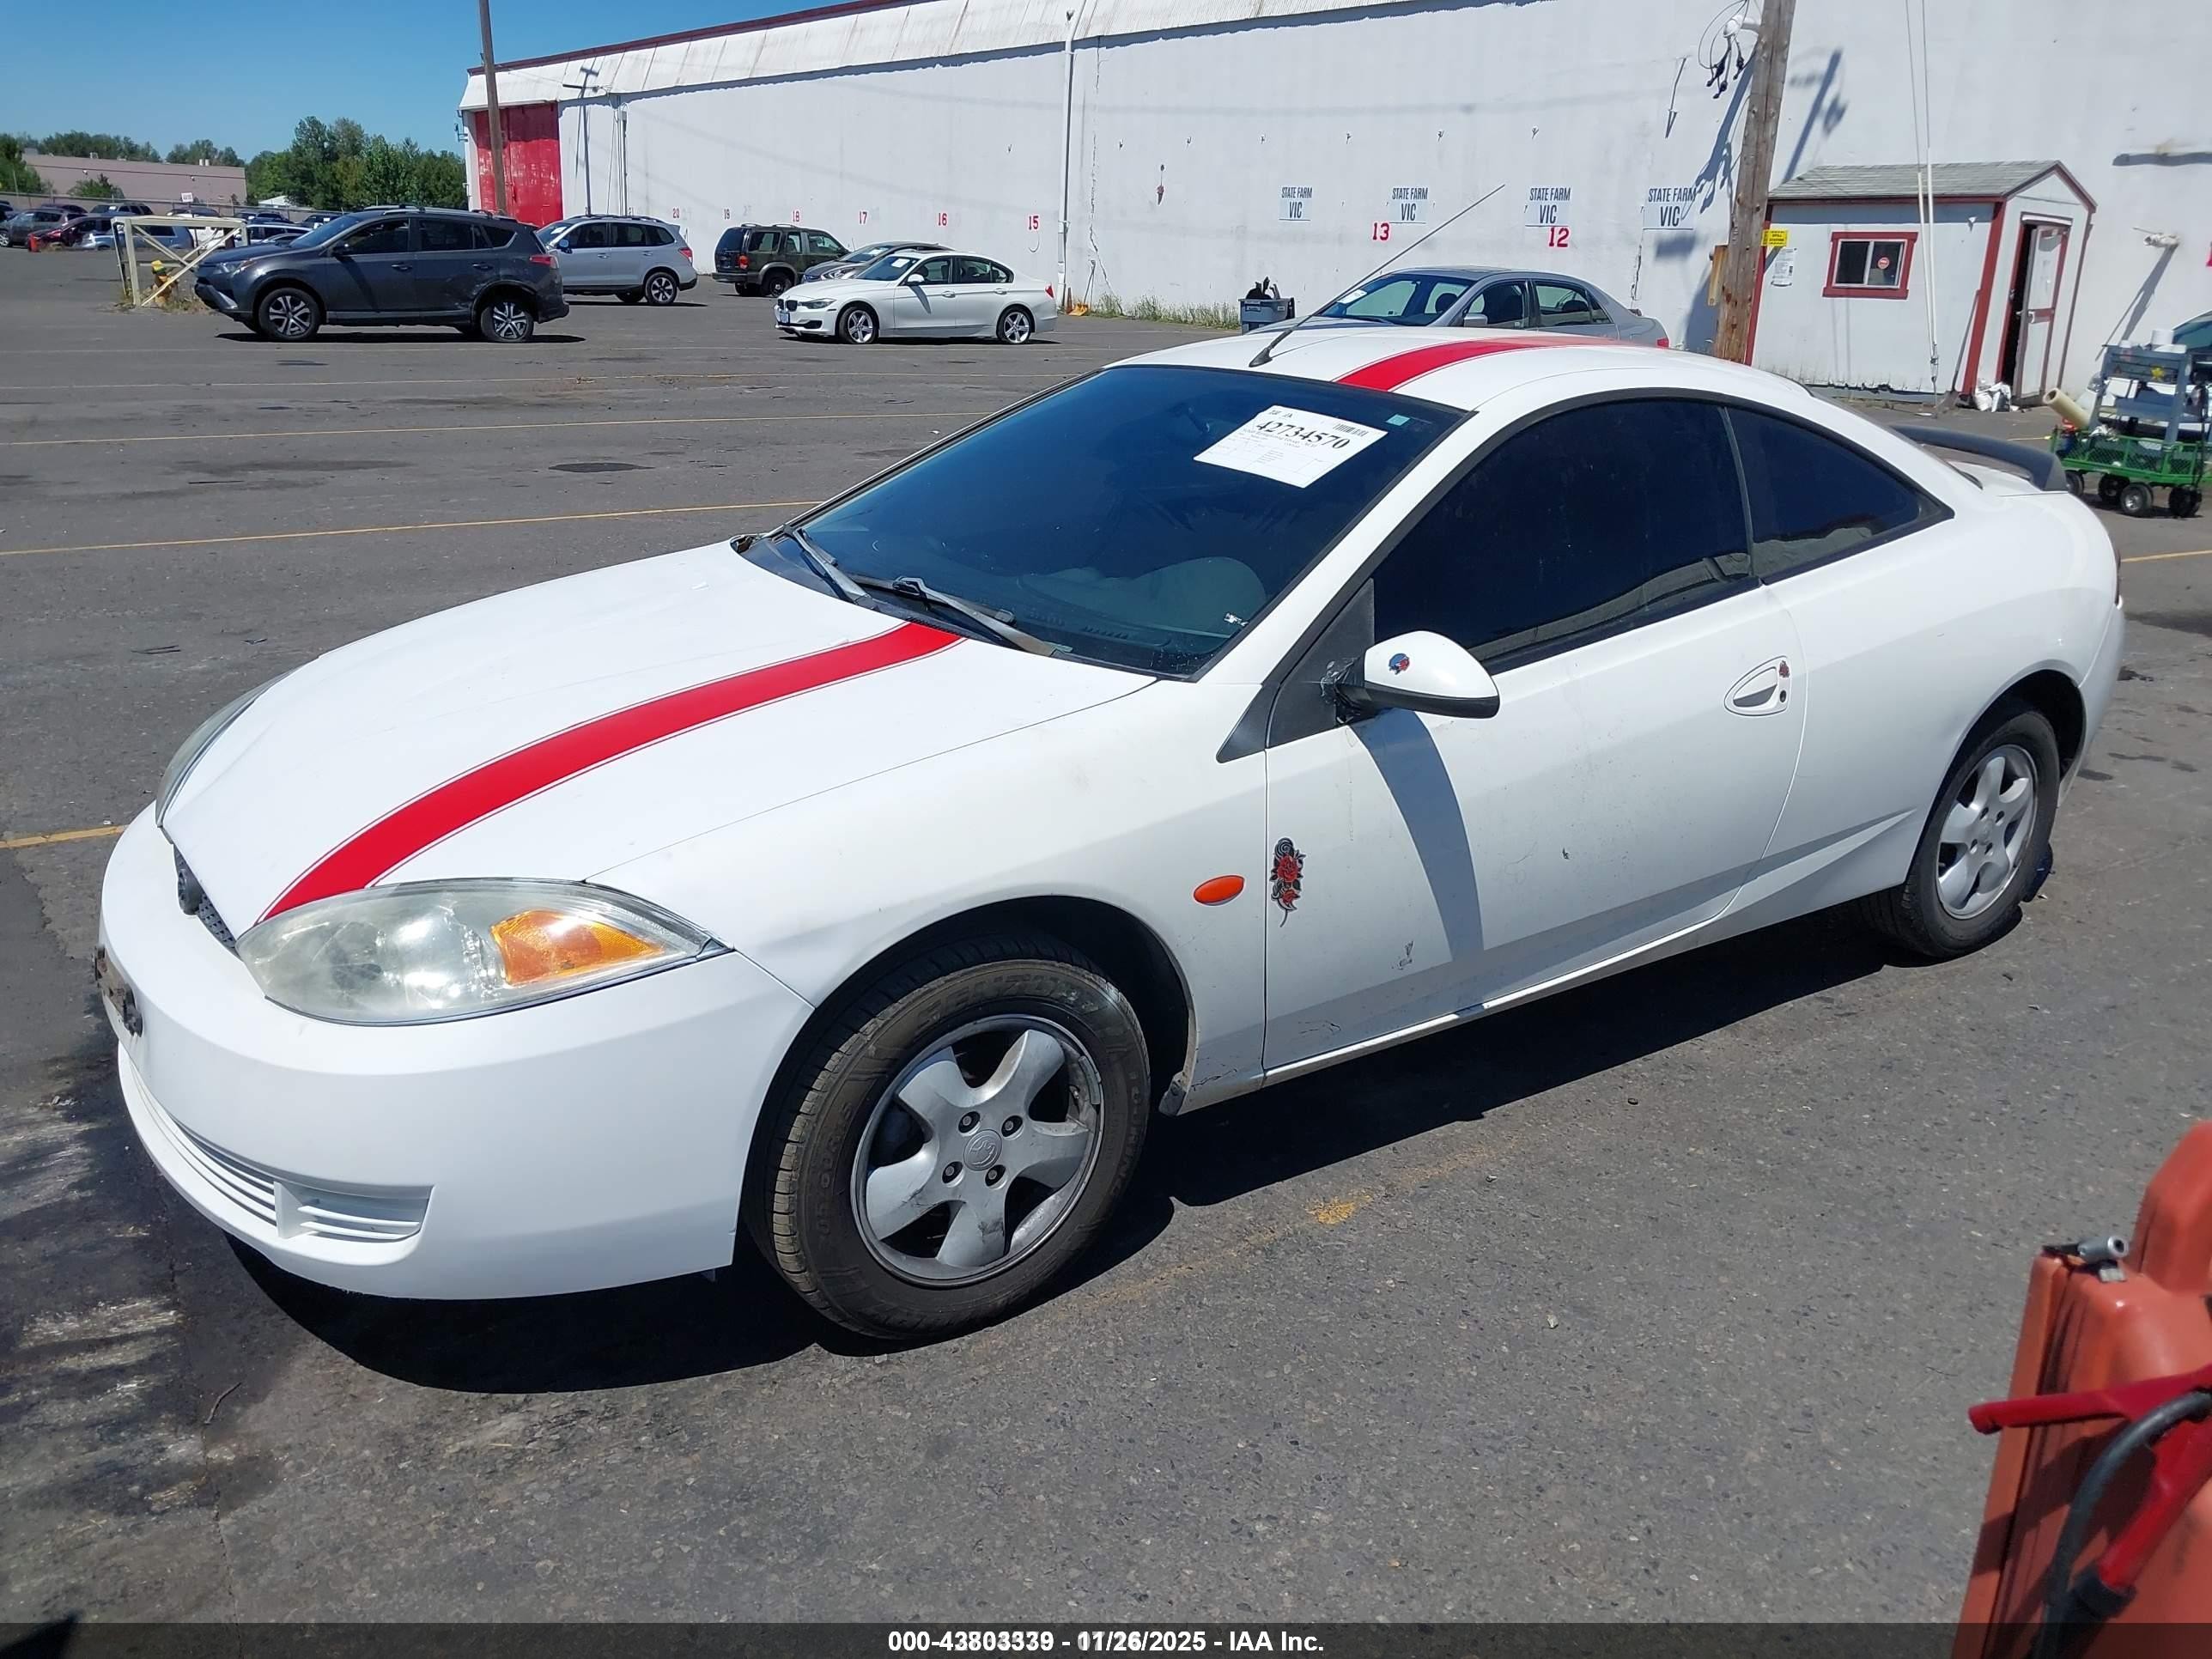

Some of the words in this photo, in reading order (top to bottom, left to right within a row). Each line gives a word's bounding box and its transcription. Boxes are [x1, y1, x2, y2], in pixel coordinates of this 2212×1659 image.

[1281, 186, 1297, 199] STATE
[1297, 186, 1313, 199] FARM
[1392, 187, 1410, 200] STATE
[1410, 187, 1428, 200] FARM
[1529, 187, 1549, 201] STATE
[1549, 187, 1571, 201] FARM
[1648, 188, 1671, 203] STATE
[1672, 187, 1697, 203] FARM
[672, 208, 680, 219] 20
[724, 208, 731, 220] 19
[793, 210, 800, 222] 18
[859, 211, 867, 224] 17
[1289, 202, 1303, 219] VIC
[1401, 203, 1417, 222] VIC
[1539, 204, 1557, 224] VIC
[1660, 206, 1680, 227] VIC
[938, 212, 948, 226] 16
[1028, 216, 1039, 230] 15
[1372, 222, 1390, 240] 13
[1548, 228, 1570, 248] 12
[1256, 420, 1351, 449] 42734570
